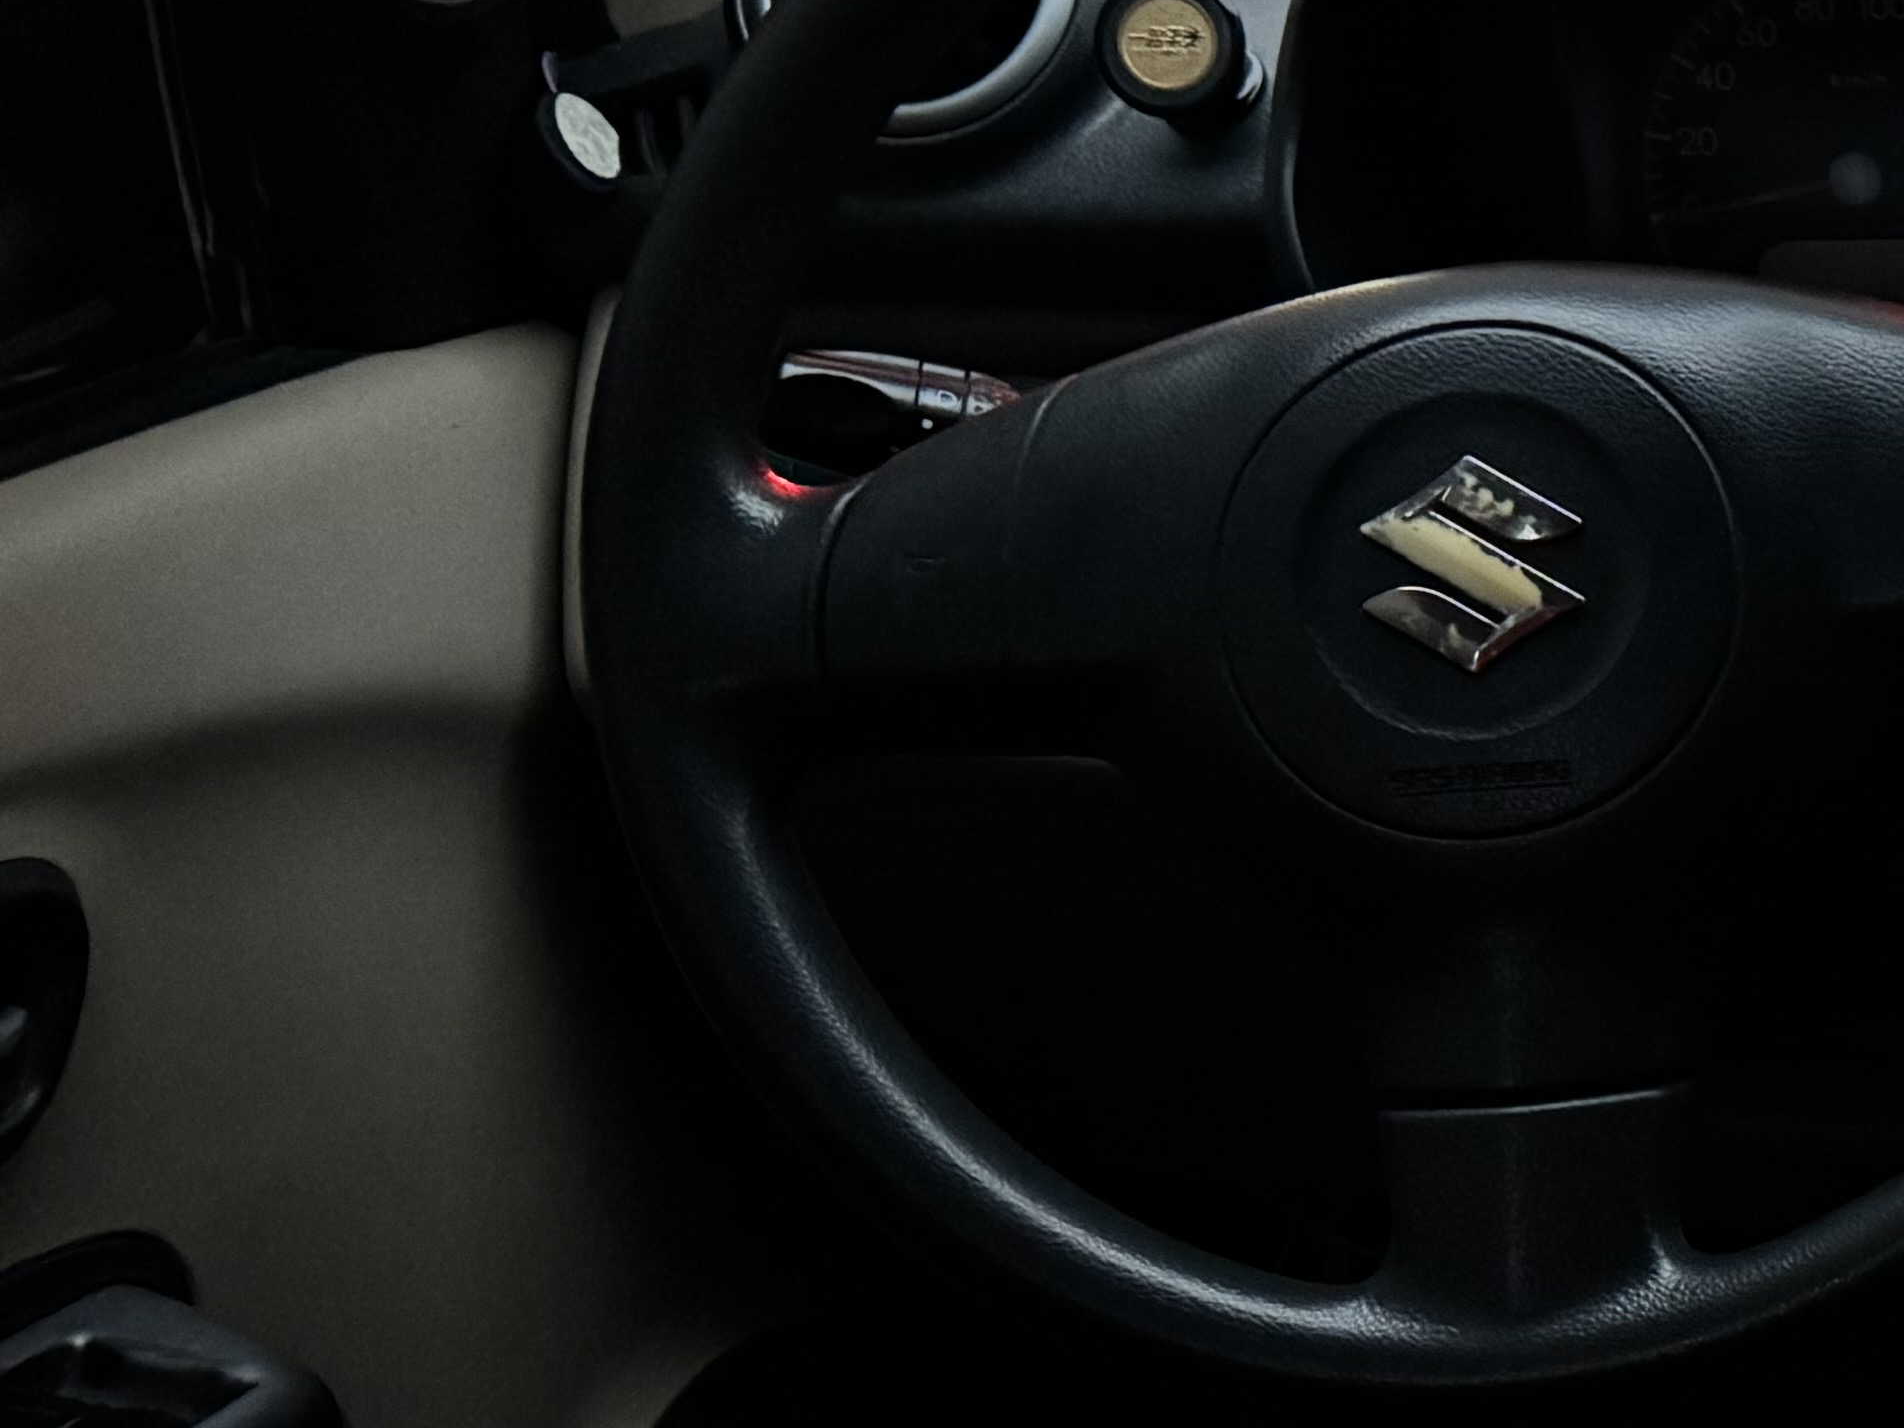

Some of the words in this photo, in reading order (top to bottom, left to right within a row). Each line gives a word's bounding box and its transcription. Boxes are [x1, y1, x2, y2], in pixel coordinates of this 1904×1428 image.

[1735, 18, 1777, 48] 60
[1695, 60, 1737, 91] 40
[1675, 125, 1720, 157] 20
